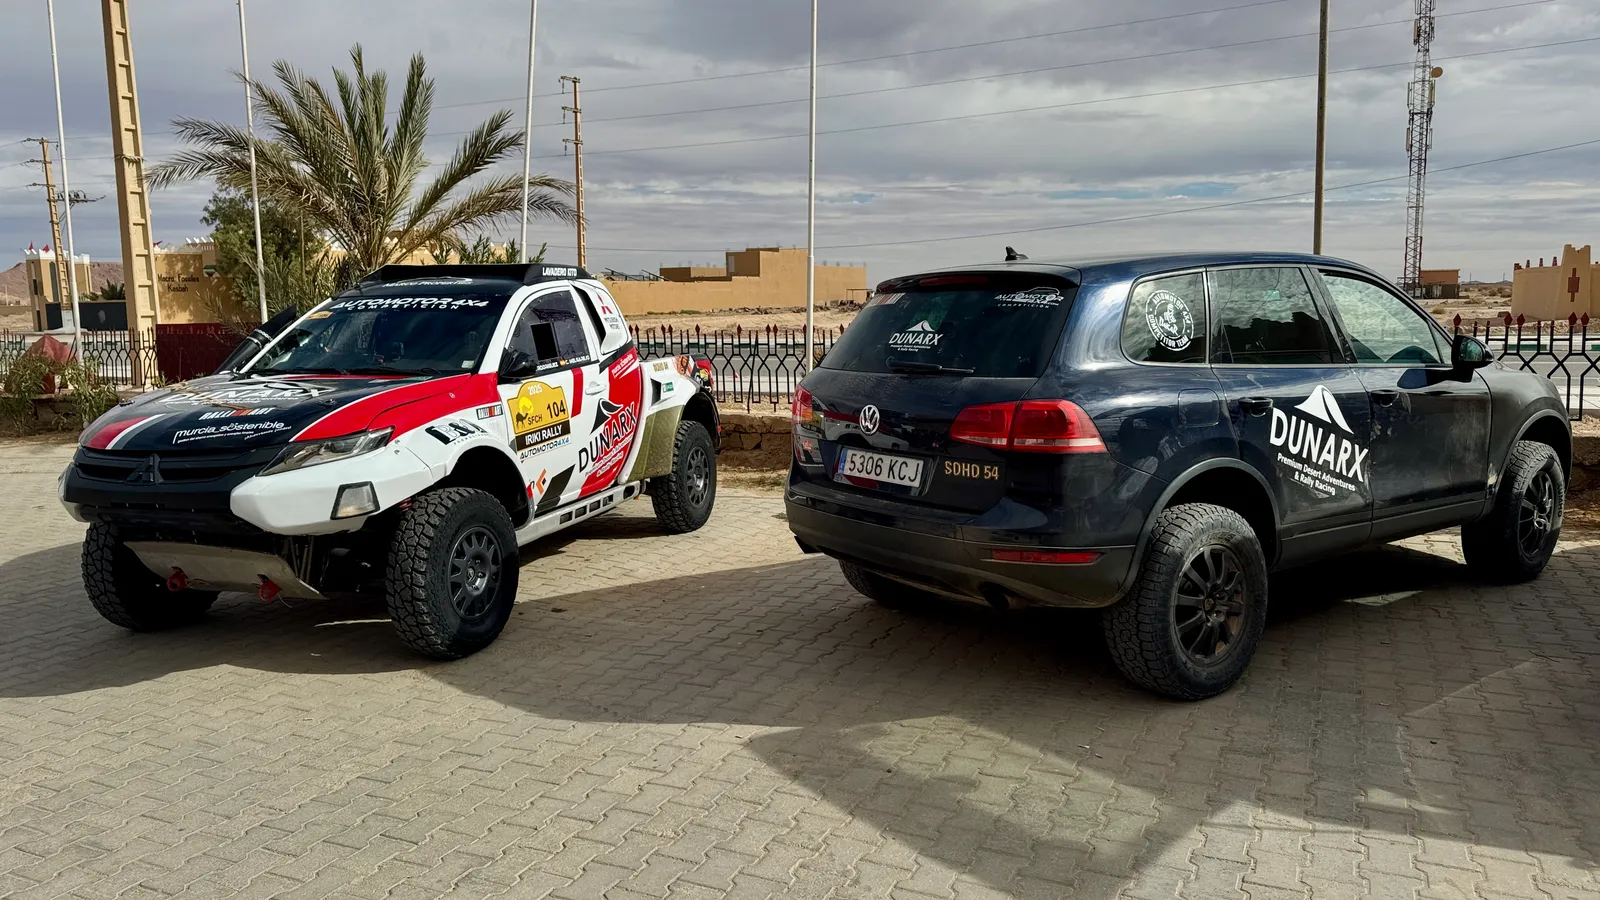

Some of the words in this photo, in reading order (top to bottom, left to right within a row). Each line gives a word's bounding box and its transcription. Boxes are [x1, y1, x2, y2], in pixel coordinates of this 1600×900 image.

[889, 332, 944, 346] DUNARX
[158, 388, 333, 403] DUNARX
[527, 384, 543, 396] 2025
[546, 399, 566, 419] 104
[527, 414, 543, 426] SFCH
[525, 431, 541, 446] IRIKI
[541, 424, 563, 440] RALLY
[578, 402, 637, 474] DUNARX
[1269, 406, 1369, 483] DUNARX
[848, 452, 884, 477] 5306
[887, 458, 920, 482] KCJ
[983, 465, 999, 480] 54
[1277, 452, 1303, 471] Premium
[1303, 463, 1322, 479] Desert
[1321, 471, 1356, 492] Adventures
[1294, 470, 1300, 481] &
[1299, 473, 1315, 488] Rally
[1314, 479, 1336, 496] Racing
